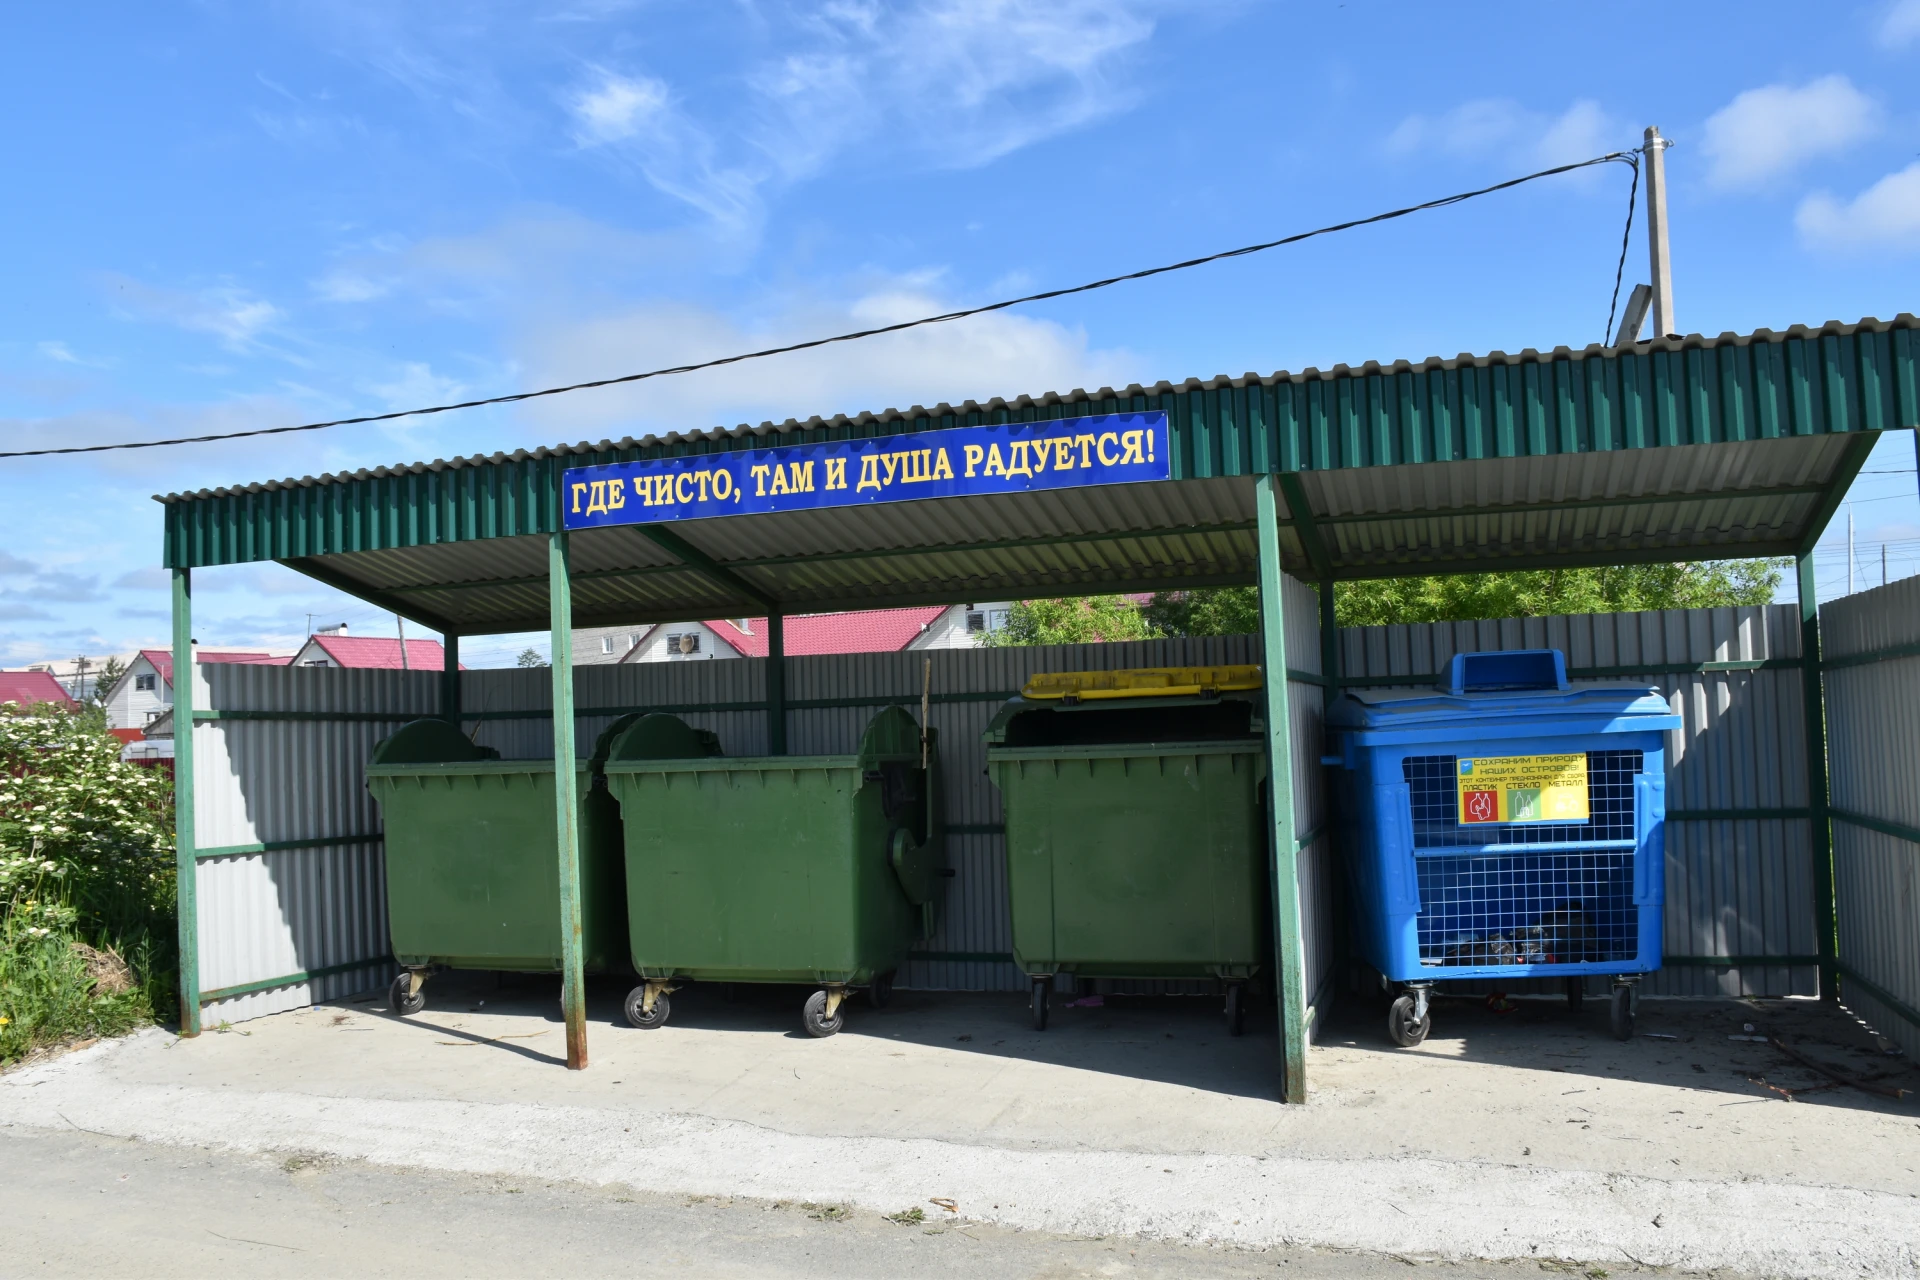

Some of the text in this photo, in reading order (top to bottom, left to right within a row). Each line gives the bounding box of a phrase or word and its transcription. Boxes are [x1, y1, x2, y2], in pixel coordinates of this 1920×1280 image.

[572, 430, 1155, 516] ГДЕ ЧИСТО, ТАМ И ДУША РАДУЕТСЯ!
[1473, 755, 1585, 766] СОХРАНИМ ПРИРОДУ
[1479, 764, 1579, 775] НАШИХ ОСТРОВОВ!
[1462, 780, 1583, 791] ПЛАСТИК СТЕКЛО МЕТАЛЛ
